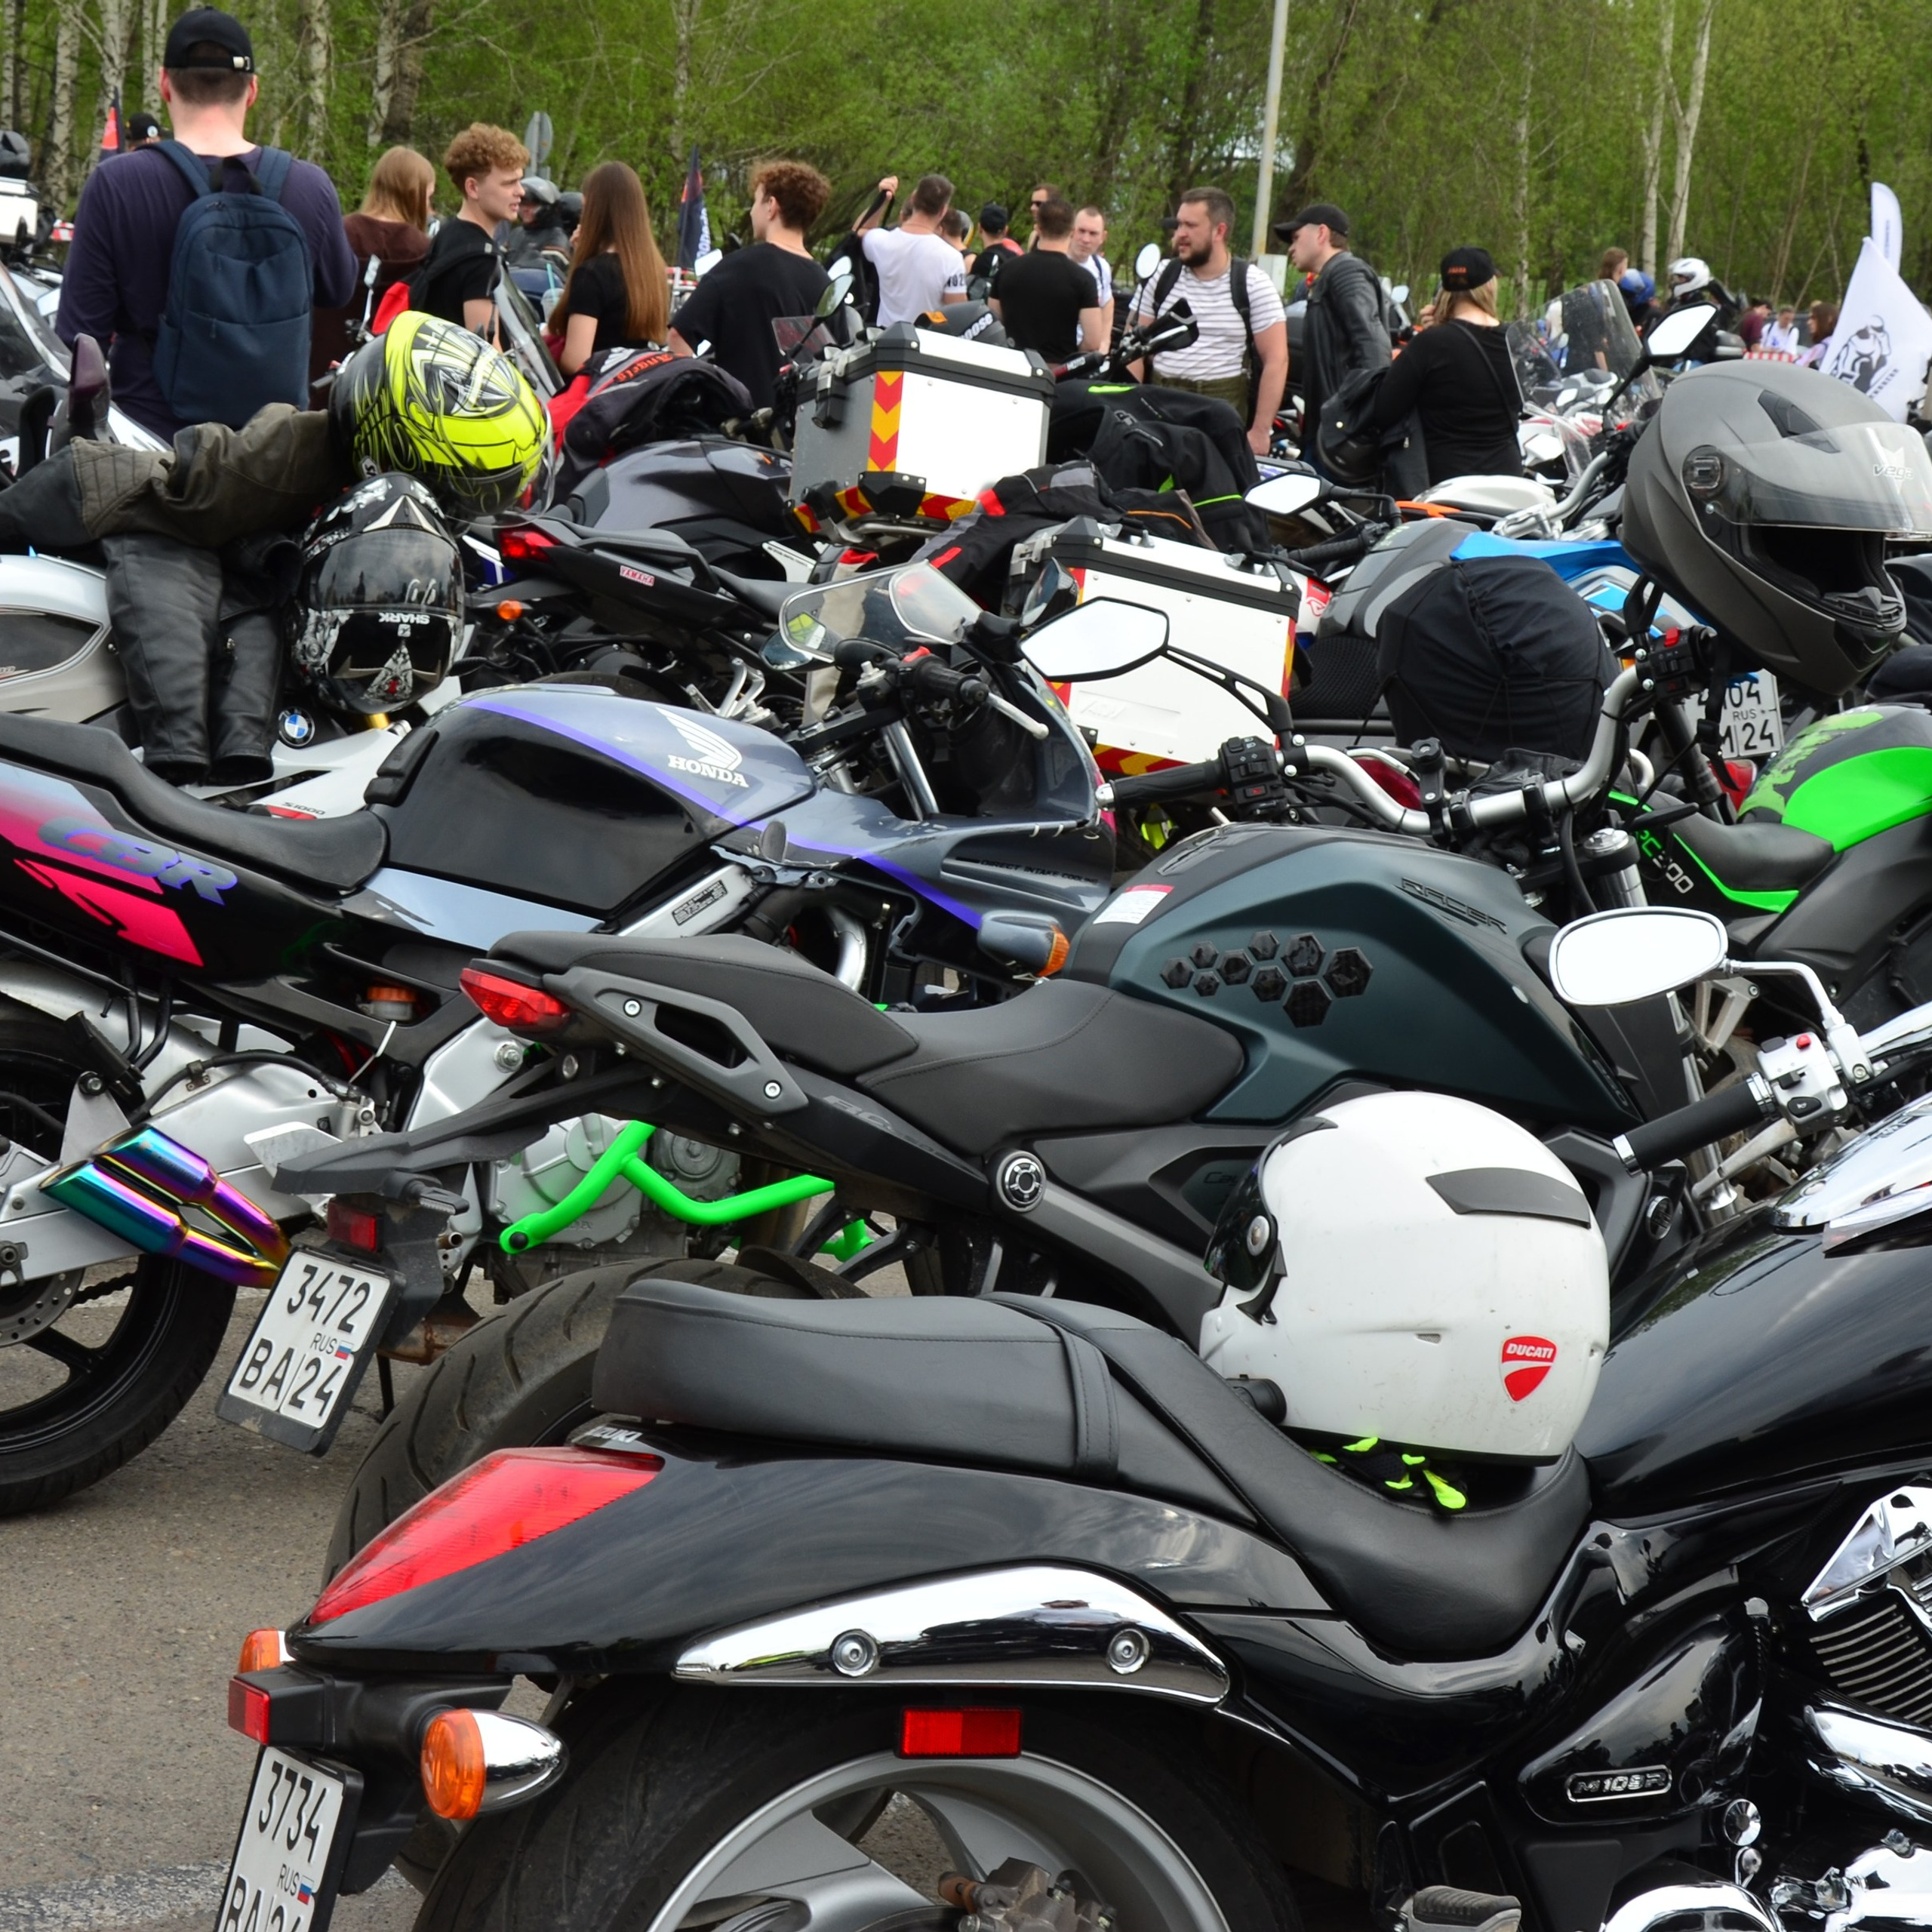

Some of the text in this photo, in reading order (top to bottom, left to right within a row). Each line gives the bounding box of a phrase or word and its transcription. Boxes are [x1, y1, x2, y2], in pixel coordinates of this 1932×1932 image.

[1873, 464, 1915, 481] vega
[621, 568, 654, 586] YAMAHA
[379, 612, 430, 625] SHARK
[1733, 709, 1757, 721] RUS
[1742, 719, 1774, 751] 24
[668, 755, 749, 788] HONDA
[283, 802, 326, 815] S1000
[38, 817, 238, 906] CBR
[981, 859, 1020, 871] DIRECT
[1023, 864, 1060, 878] INTAKE
[1401, 878, 1508, 935] RACER
[288, 1264, 371, 1334] 3472
[310, 1333, 337, 1355] RUS
[1506, 1343, 1554, 1358] DUCATI
[289, 1357, 343, 1417] 24
[259, 1761, 327, 1863] 3734
[278, 1864, 300, 1896] RUS
